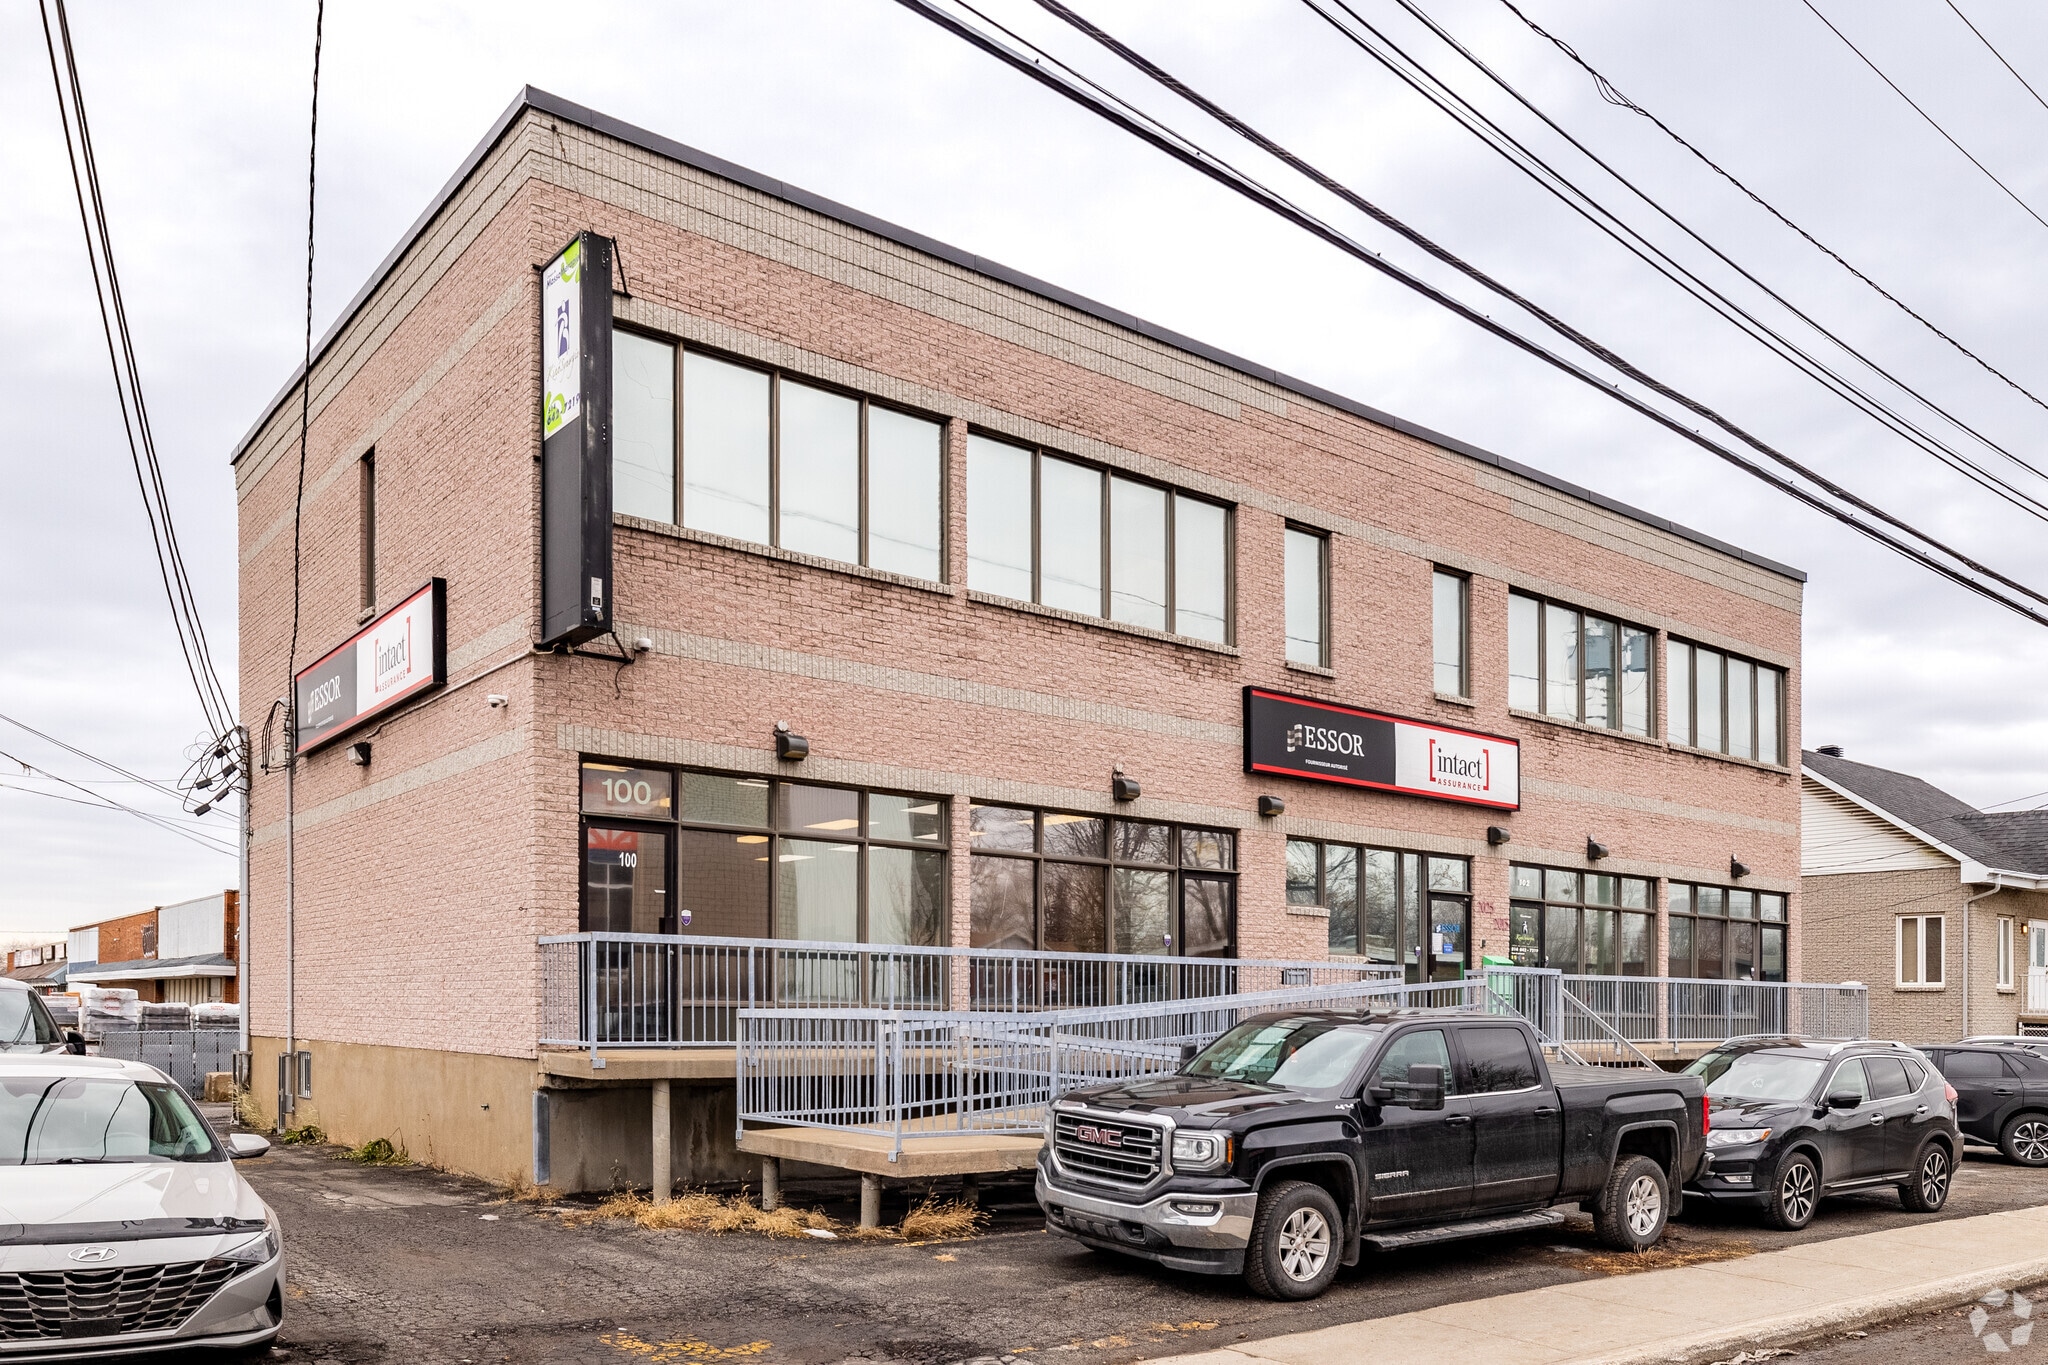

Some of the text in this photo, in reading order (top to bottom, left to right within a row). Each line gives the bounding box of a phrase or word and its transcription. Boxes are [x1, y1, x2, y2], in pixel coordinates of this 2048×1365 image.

[379, 633, 406, 676] intact
[314, 675, 341, 711] ESSOR
[379, 669, 406, 692] ASSURANCE
[1304, 725, 1365, 757] ESSOR
[1437, 747, 1483, 779] intact
[602, 778, 651, 805] 100
[1437, 778, 1481, 791] ASSURANCE
[619, 852, 637, 868] 100
[1077, 1125, 1122, 1148] GMC
[1374, 1170, 1410, 1180] SIERRA
